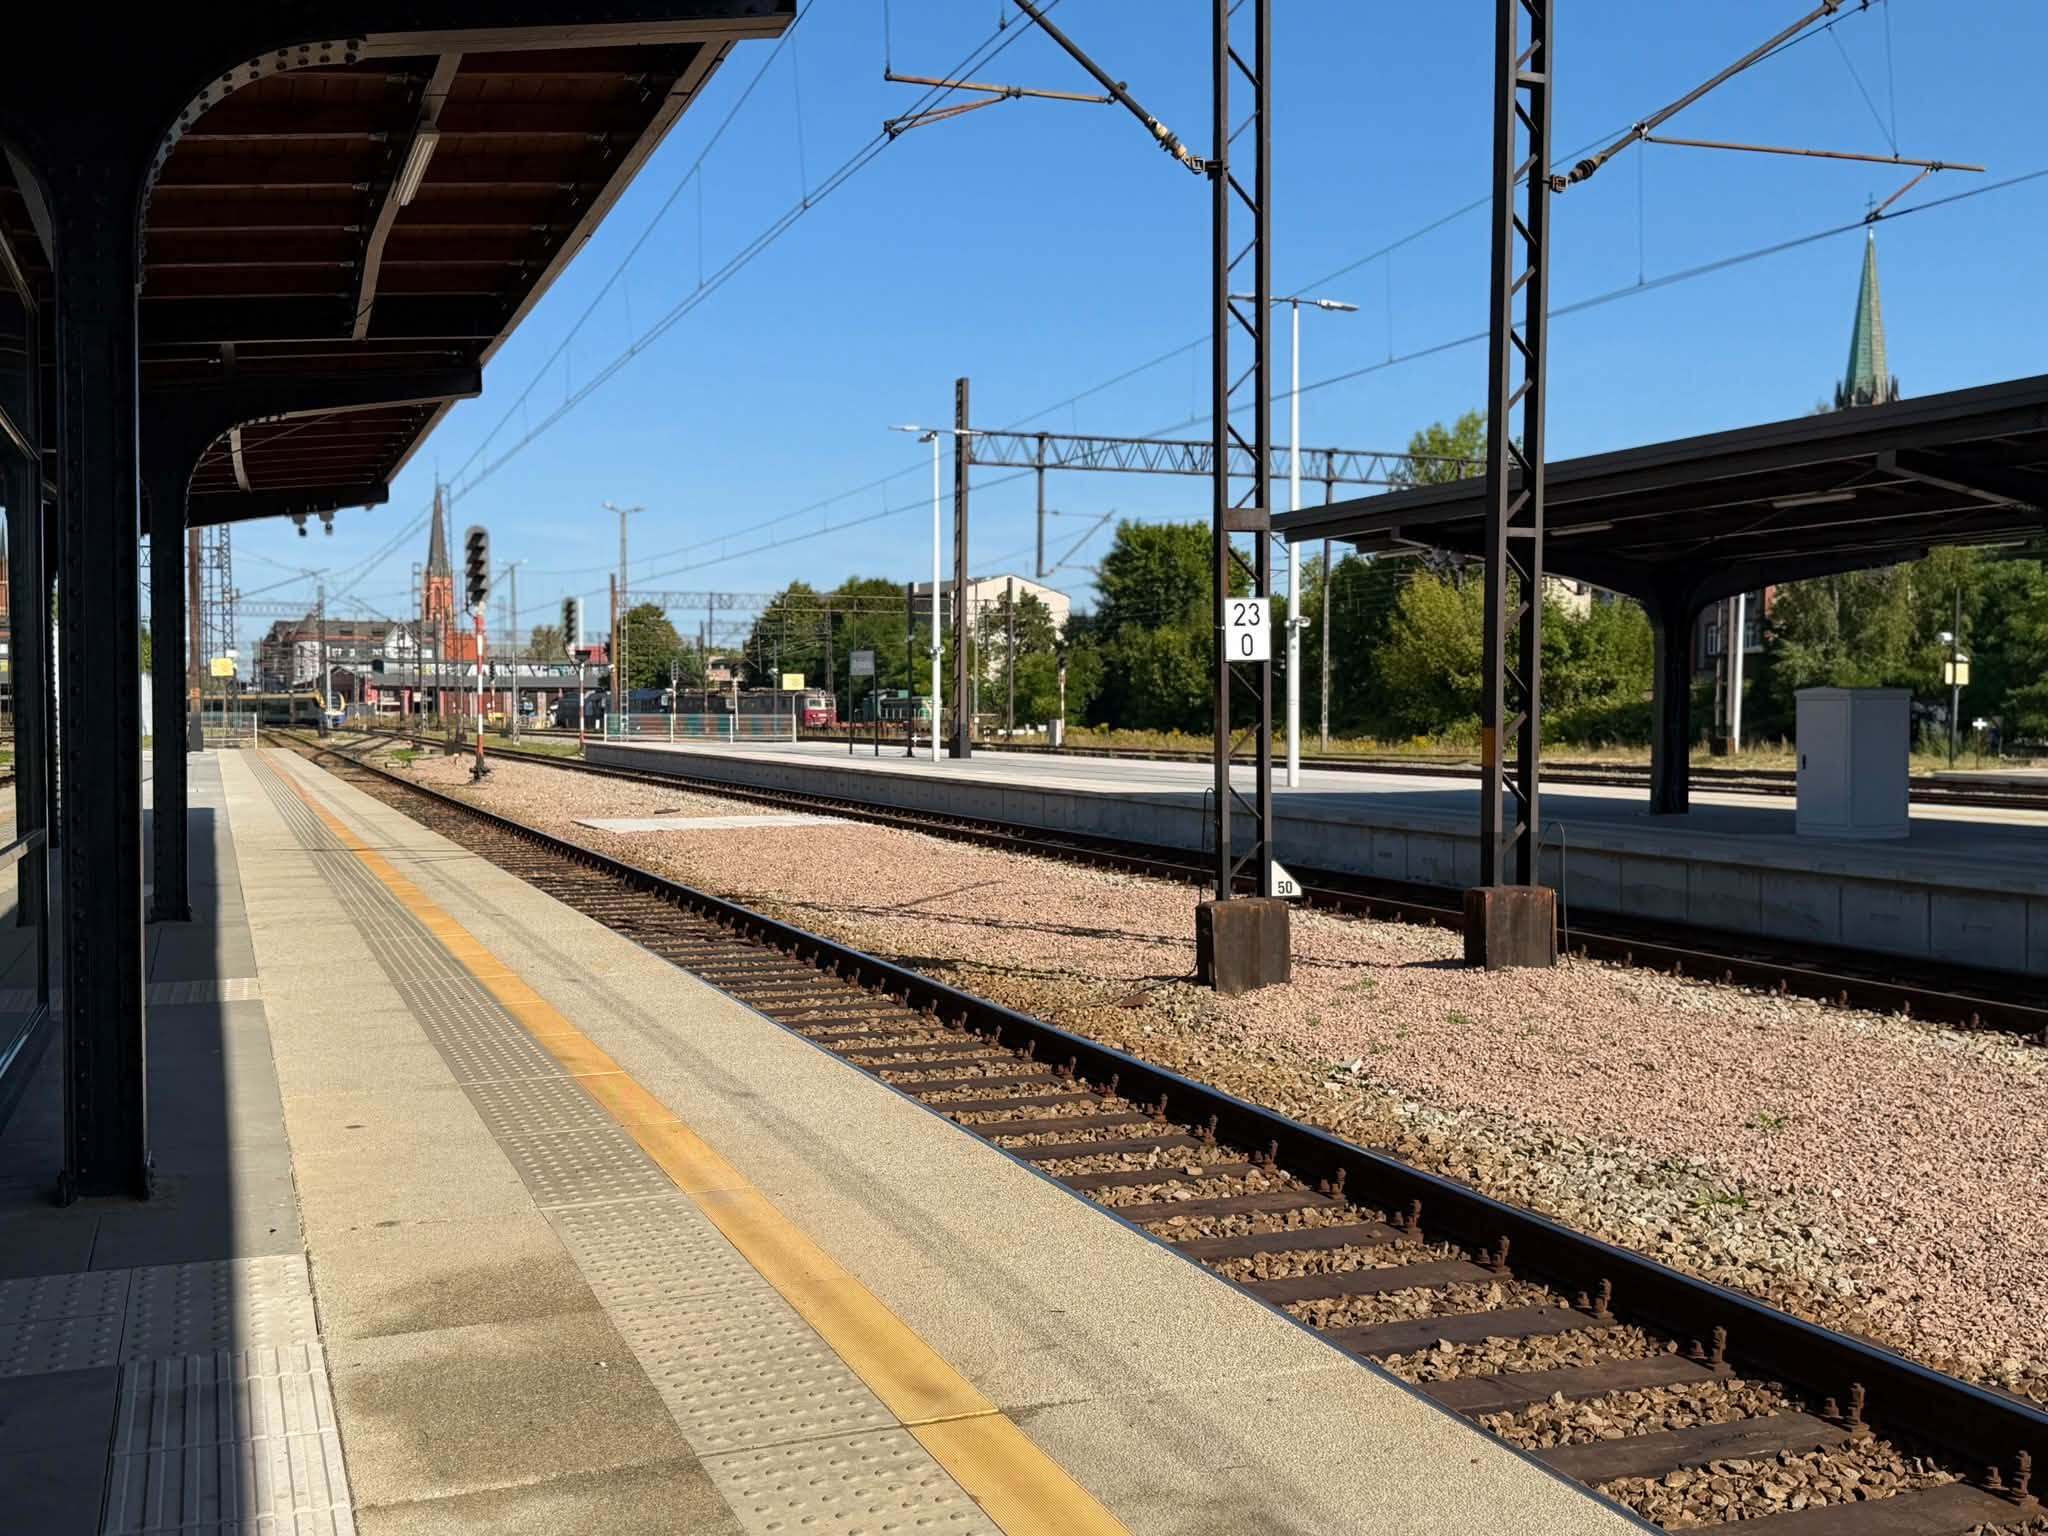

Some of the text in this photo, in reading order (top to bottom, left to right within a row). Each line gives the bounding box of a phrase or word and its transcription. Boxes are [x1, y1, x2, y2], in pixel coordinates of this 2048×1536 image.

[1233, 603, 1260, 627] 23
[1241, 633, 1253, 657] 0
[1278, 880, 1293, 894] 50
